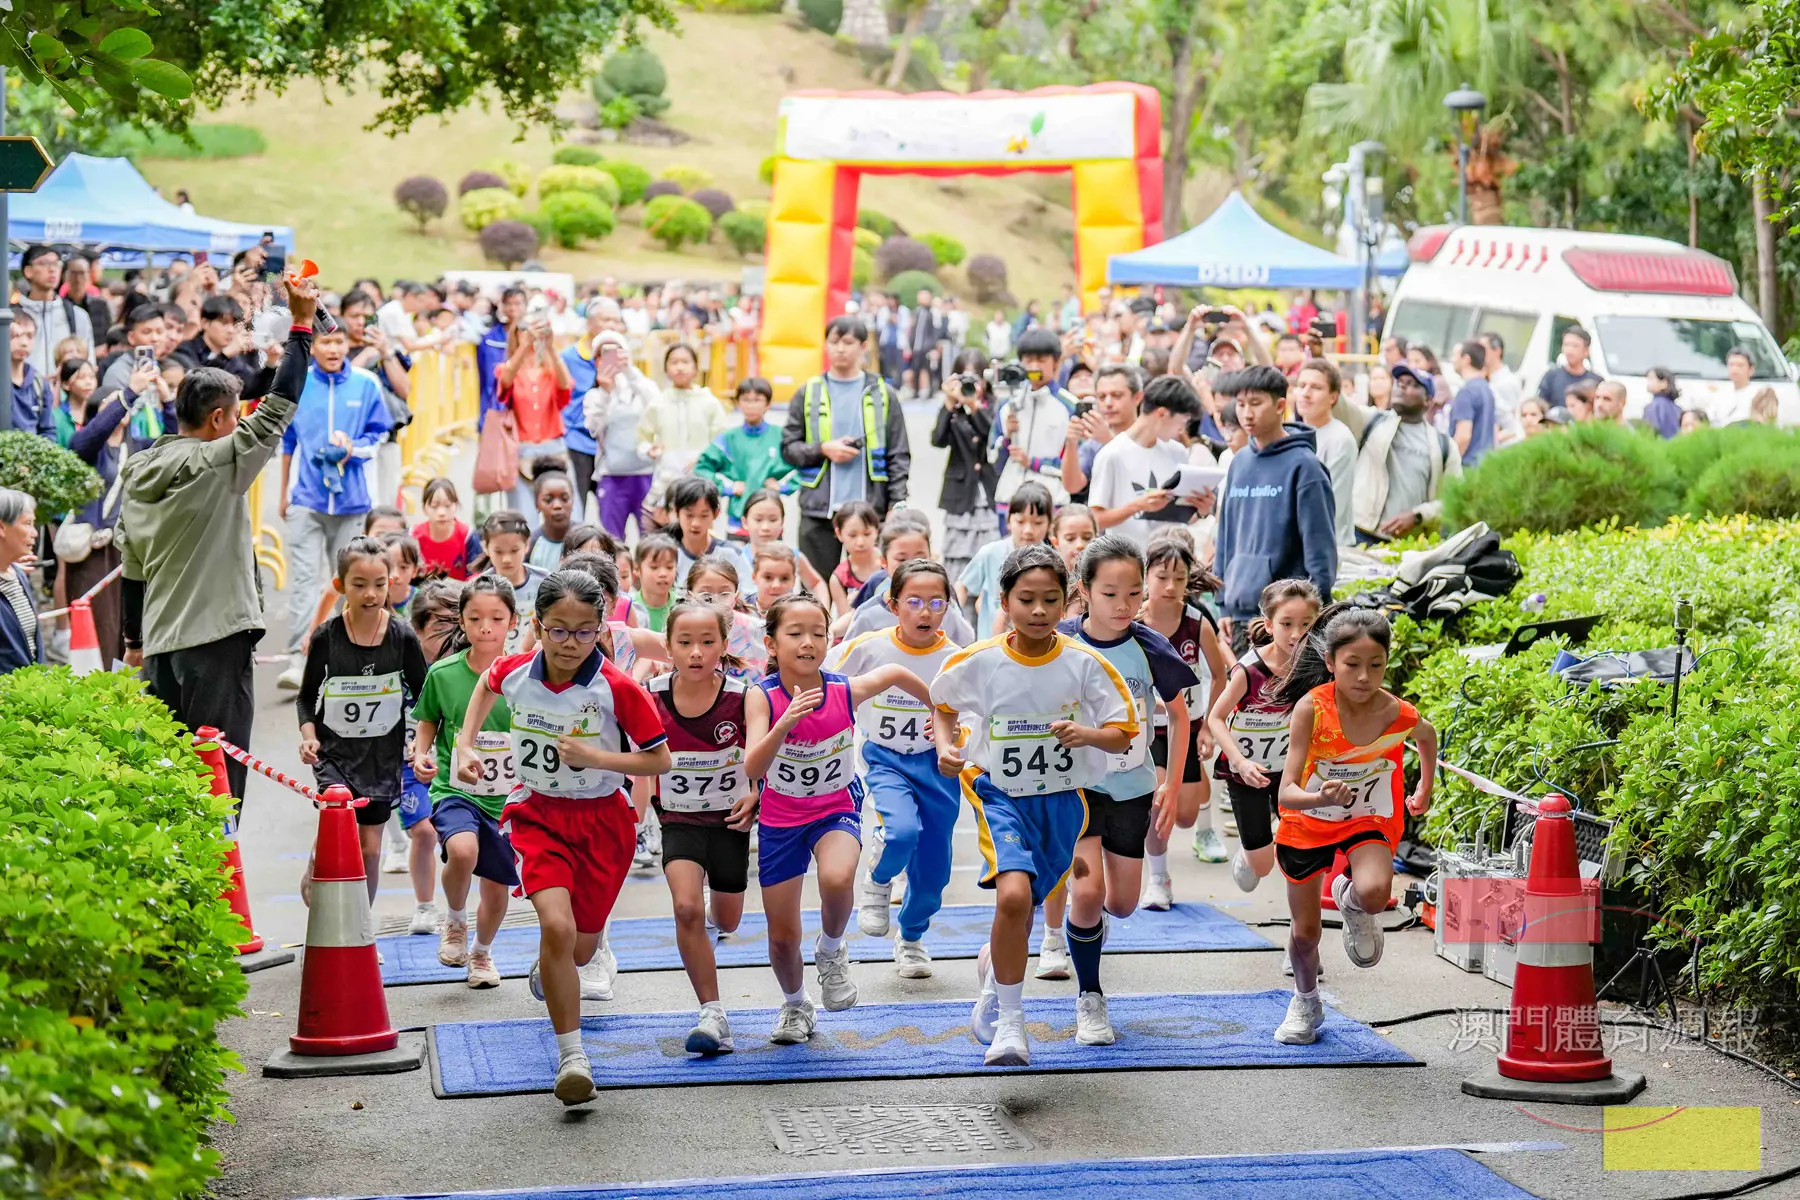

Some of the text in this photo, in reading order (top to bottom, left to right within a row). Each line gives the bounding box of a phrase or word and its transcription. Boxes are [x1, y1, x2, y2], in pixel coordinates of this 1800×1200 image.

[344, 701, 382, 723] 97
[878, 716, 933, 741] 54
[520, 738, 586, 774] 29
[1237, 733, 1290, 760] 372
[483, 755, 516, 782] 39
[778, 758, 842, 787] 592
[1002, 744, 1074, 778] 543
[670, 770, 737, 796] 375
